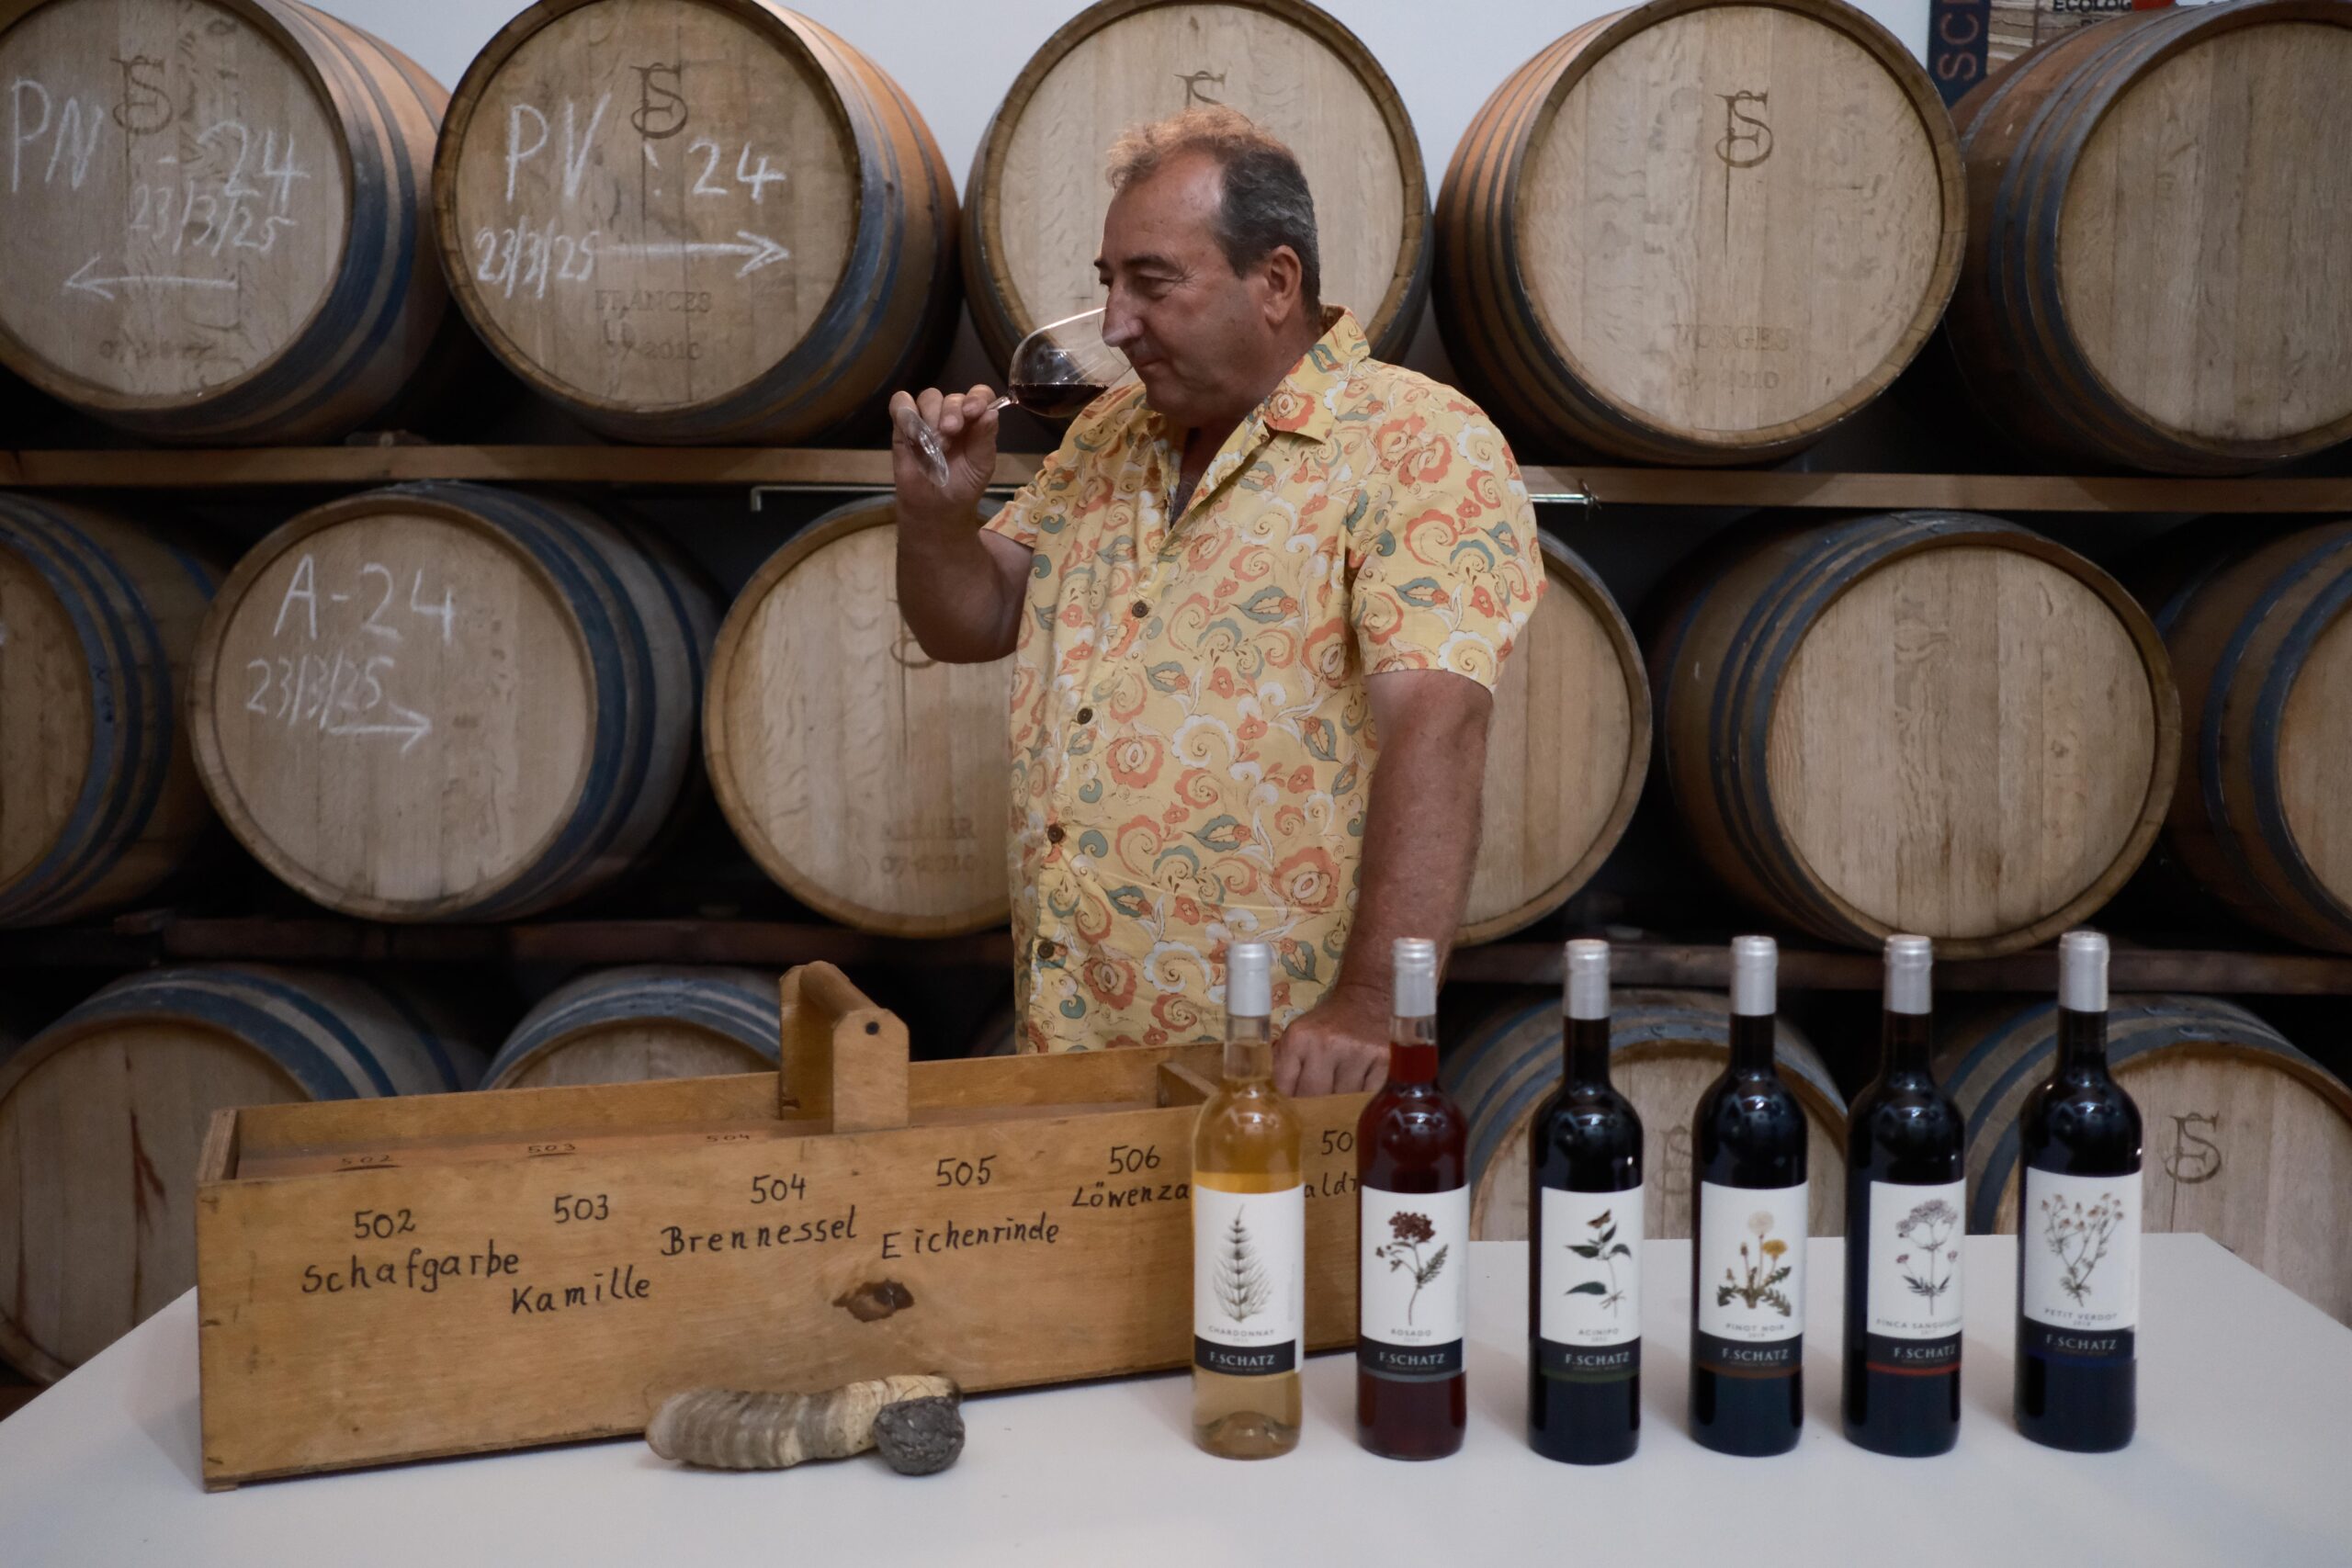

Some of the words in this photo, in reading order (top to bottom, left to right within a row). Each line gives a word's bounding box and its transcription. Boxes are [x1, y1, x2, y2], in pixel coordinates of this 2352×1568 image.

[2052, 0, 2132, 12] ECOLOG
[1936, 12, 1981, 82] SC
[688, 138, 786, 205] 24
[1321, 1129, 1353, 1156] 50
[935, 1155, 997, 1188] 505
[1108, 1145, 1161, 1175] 506
[750, 1173, 807, 1204] 504
[1071, 1180, 1192, 1209] Löwenza
[1303, 1171, 1357, 1199] aldr
[354, 1209, 416, 1239] 502
[553, 1194, 610, 1224] 503
[660, 1204, 858, 1258] Brennessel
[881, 1212, 1060, 1260] Eichenrinde
[510, 1264, 651, 1315] Kamille
[1724, 1322, 1758, 1332] PINOT
[1760, 1324, 1785, 1332] NOIR
